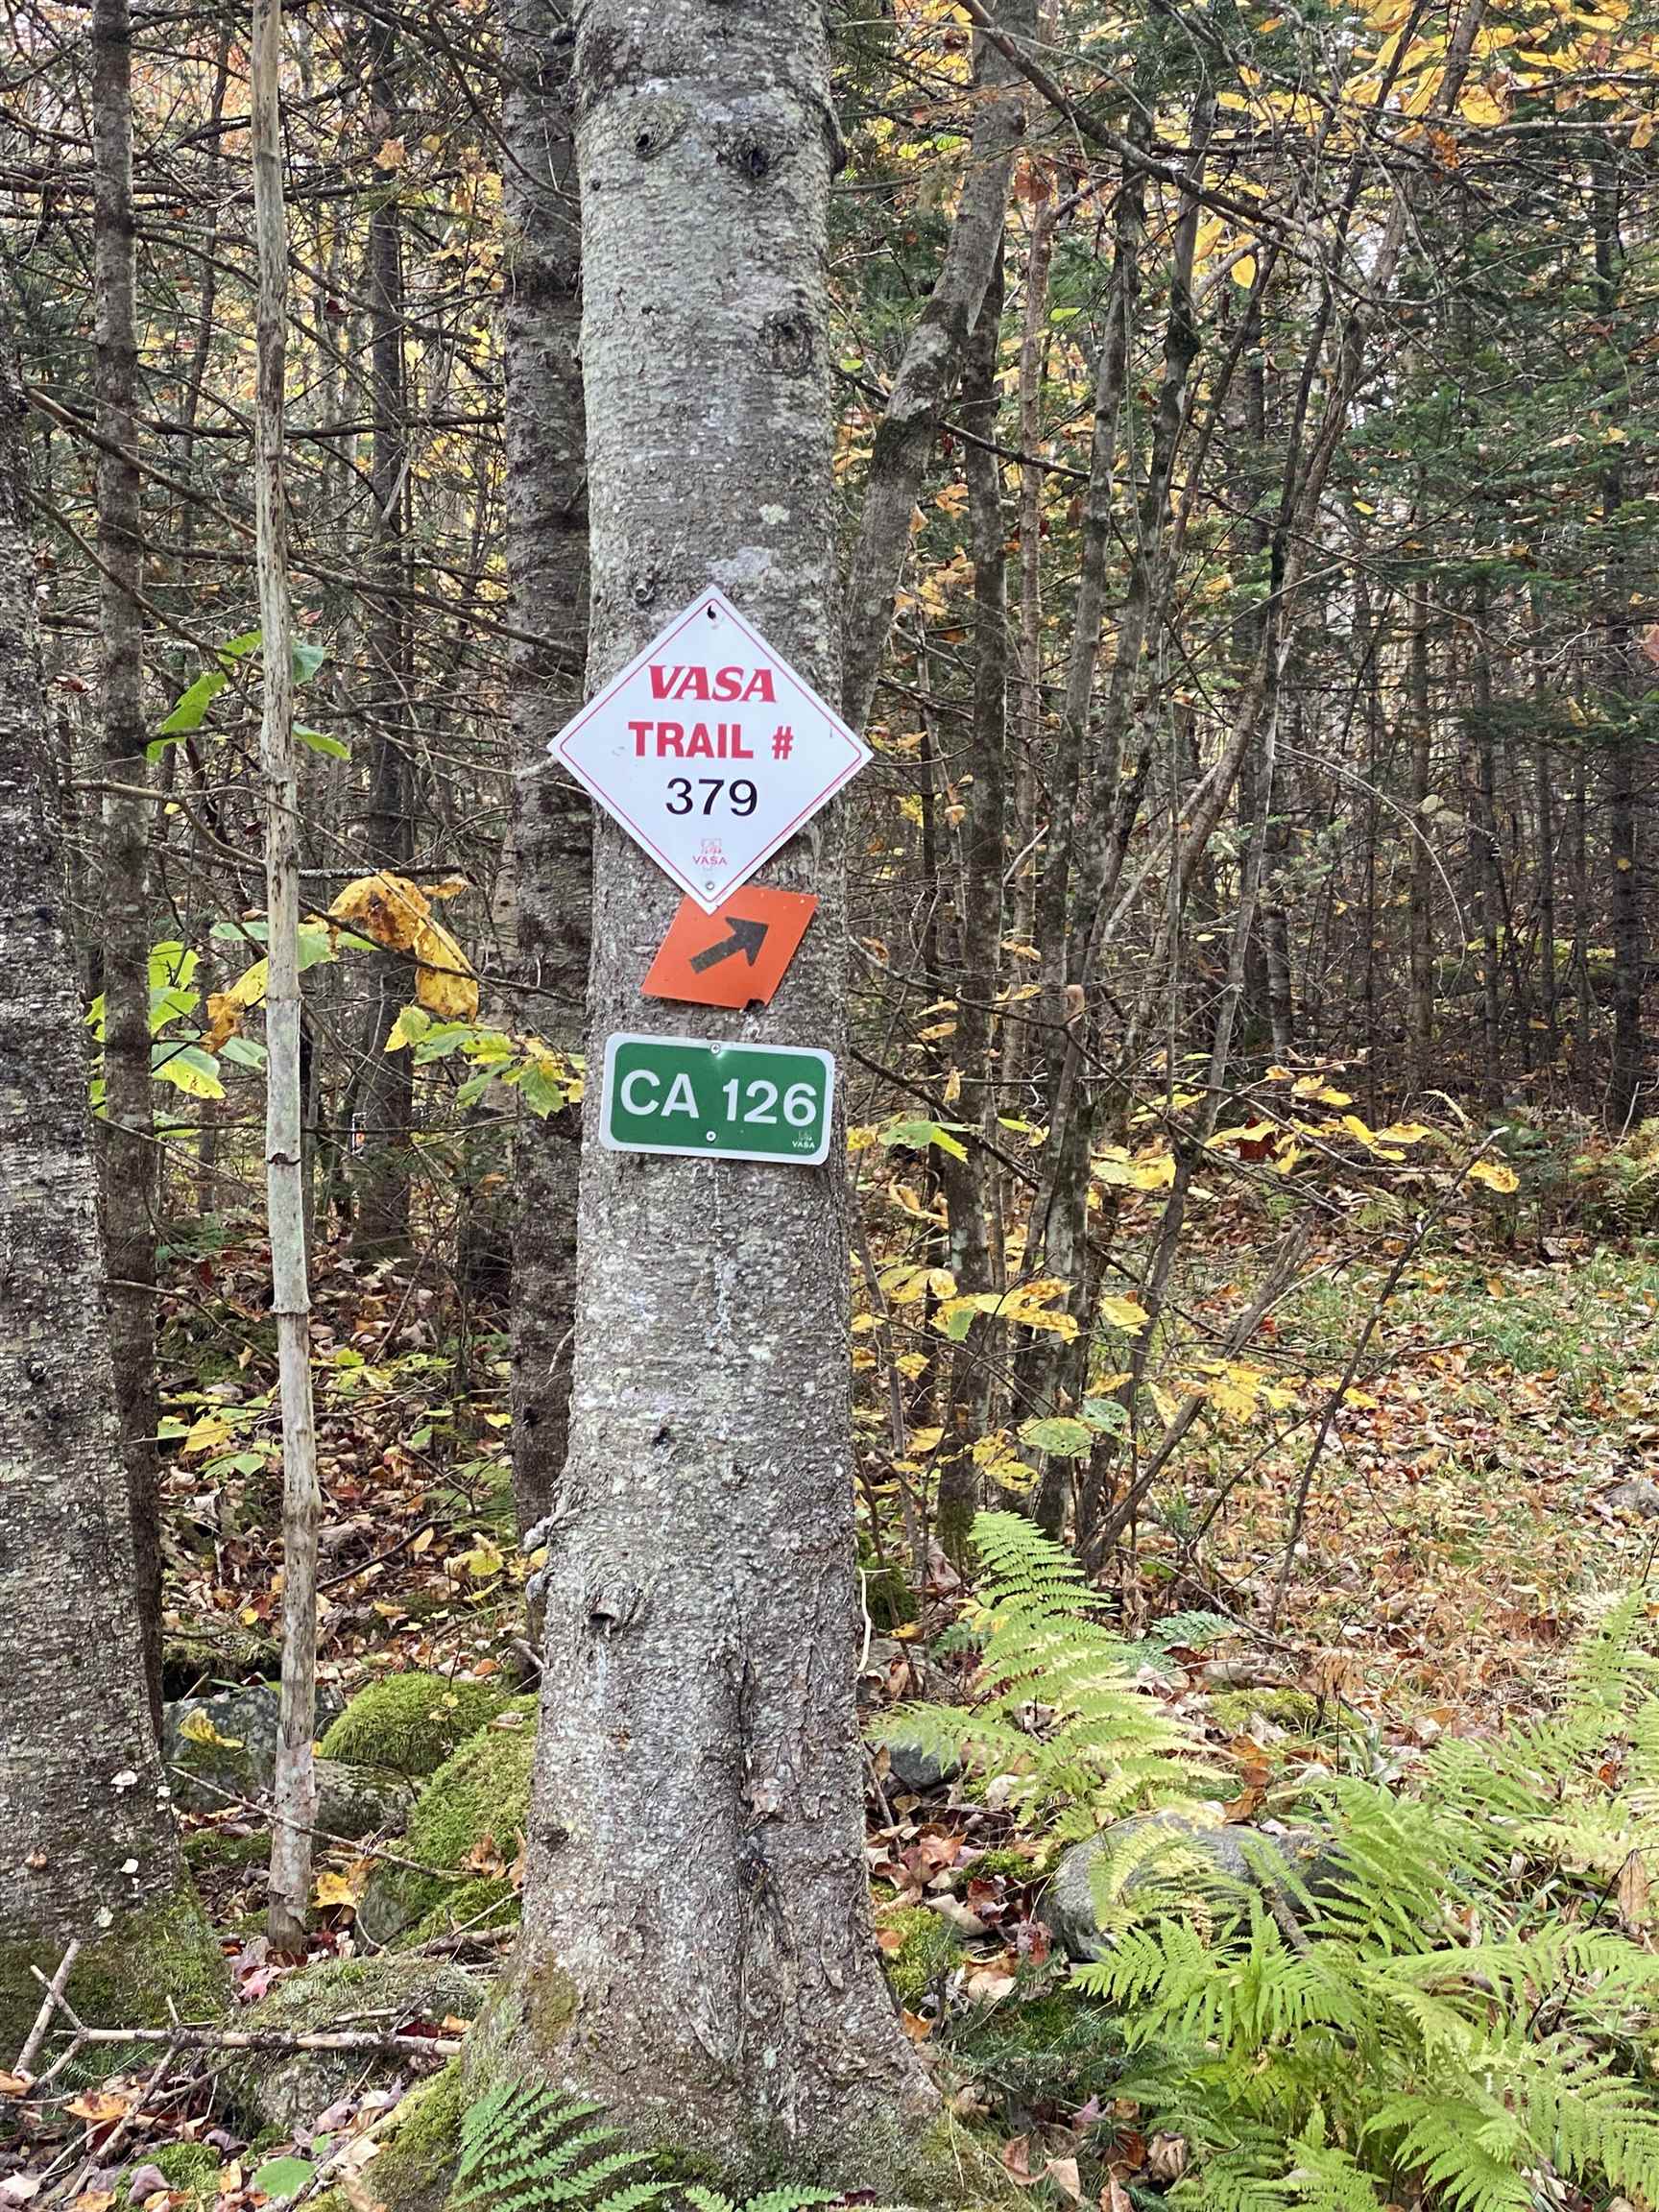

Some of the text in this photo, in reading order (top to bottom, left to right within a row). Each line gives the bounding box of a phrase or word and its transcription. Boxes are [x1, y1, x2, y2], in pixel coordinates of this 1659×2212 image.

[649, 665, 776, 703] VASA
[628, 721, 794, 760] TRAIL #
[665, 777, 758, 816] 379
[692, 854, 728, 865] VASA
[620, 1069, 817, 1127] CA 126
